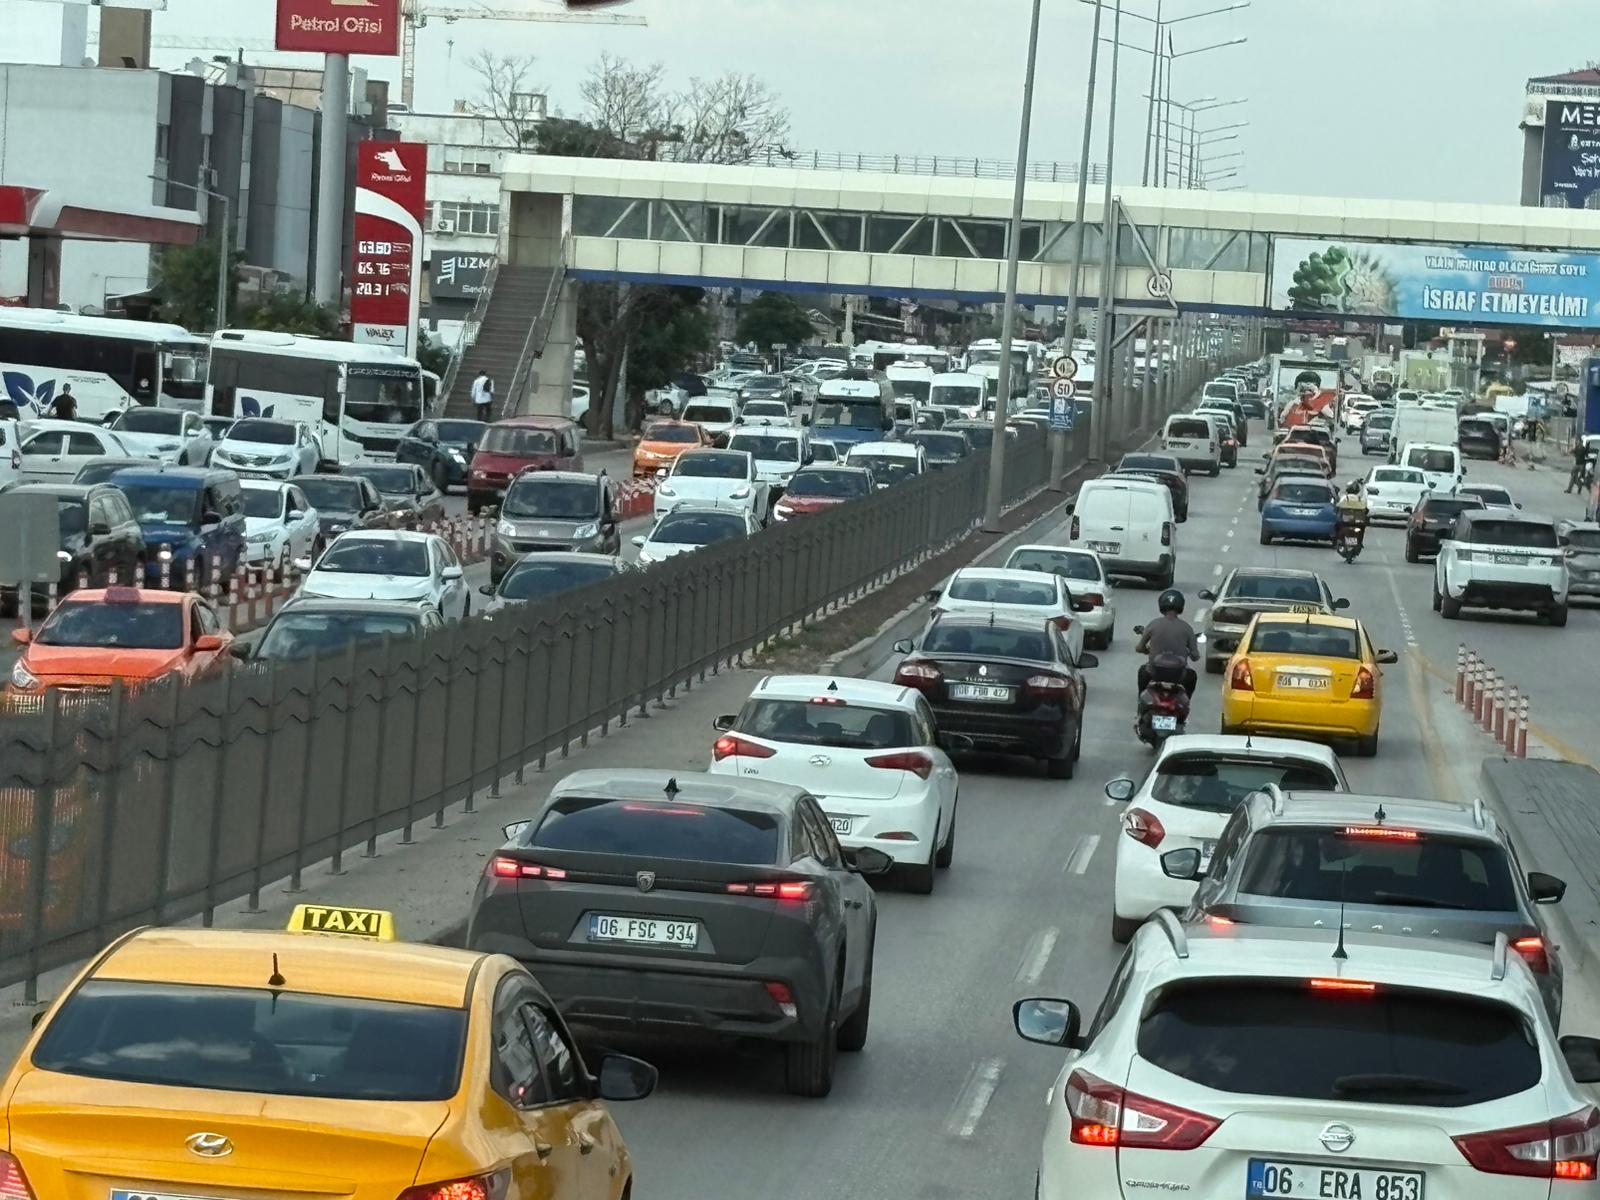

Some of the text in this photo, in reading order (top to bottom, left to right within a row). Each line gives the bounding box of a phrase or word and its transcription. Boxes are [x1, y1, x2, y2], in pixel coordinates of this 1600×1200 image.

[291, 14, 382, 33] Petrol Ofisi
[1423, 285, 1476, 312] İSRAF
[1057, 383, 1070, 395] 50
[307, 908, 379, 933] TAXI
[600, 919, 694, 941] 06 FSC 934
[1264, 1166, 1419, 1200] 06 ERA 853
